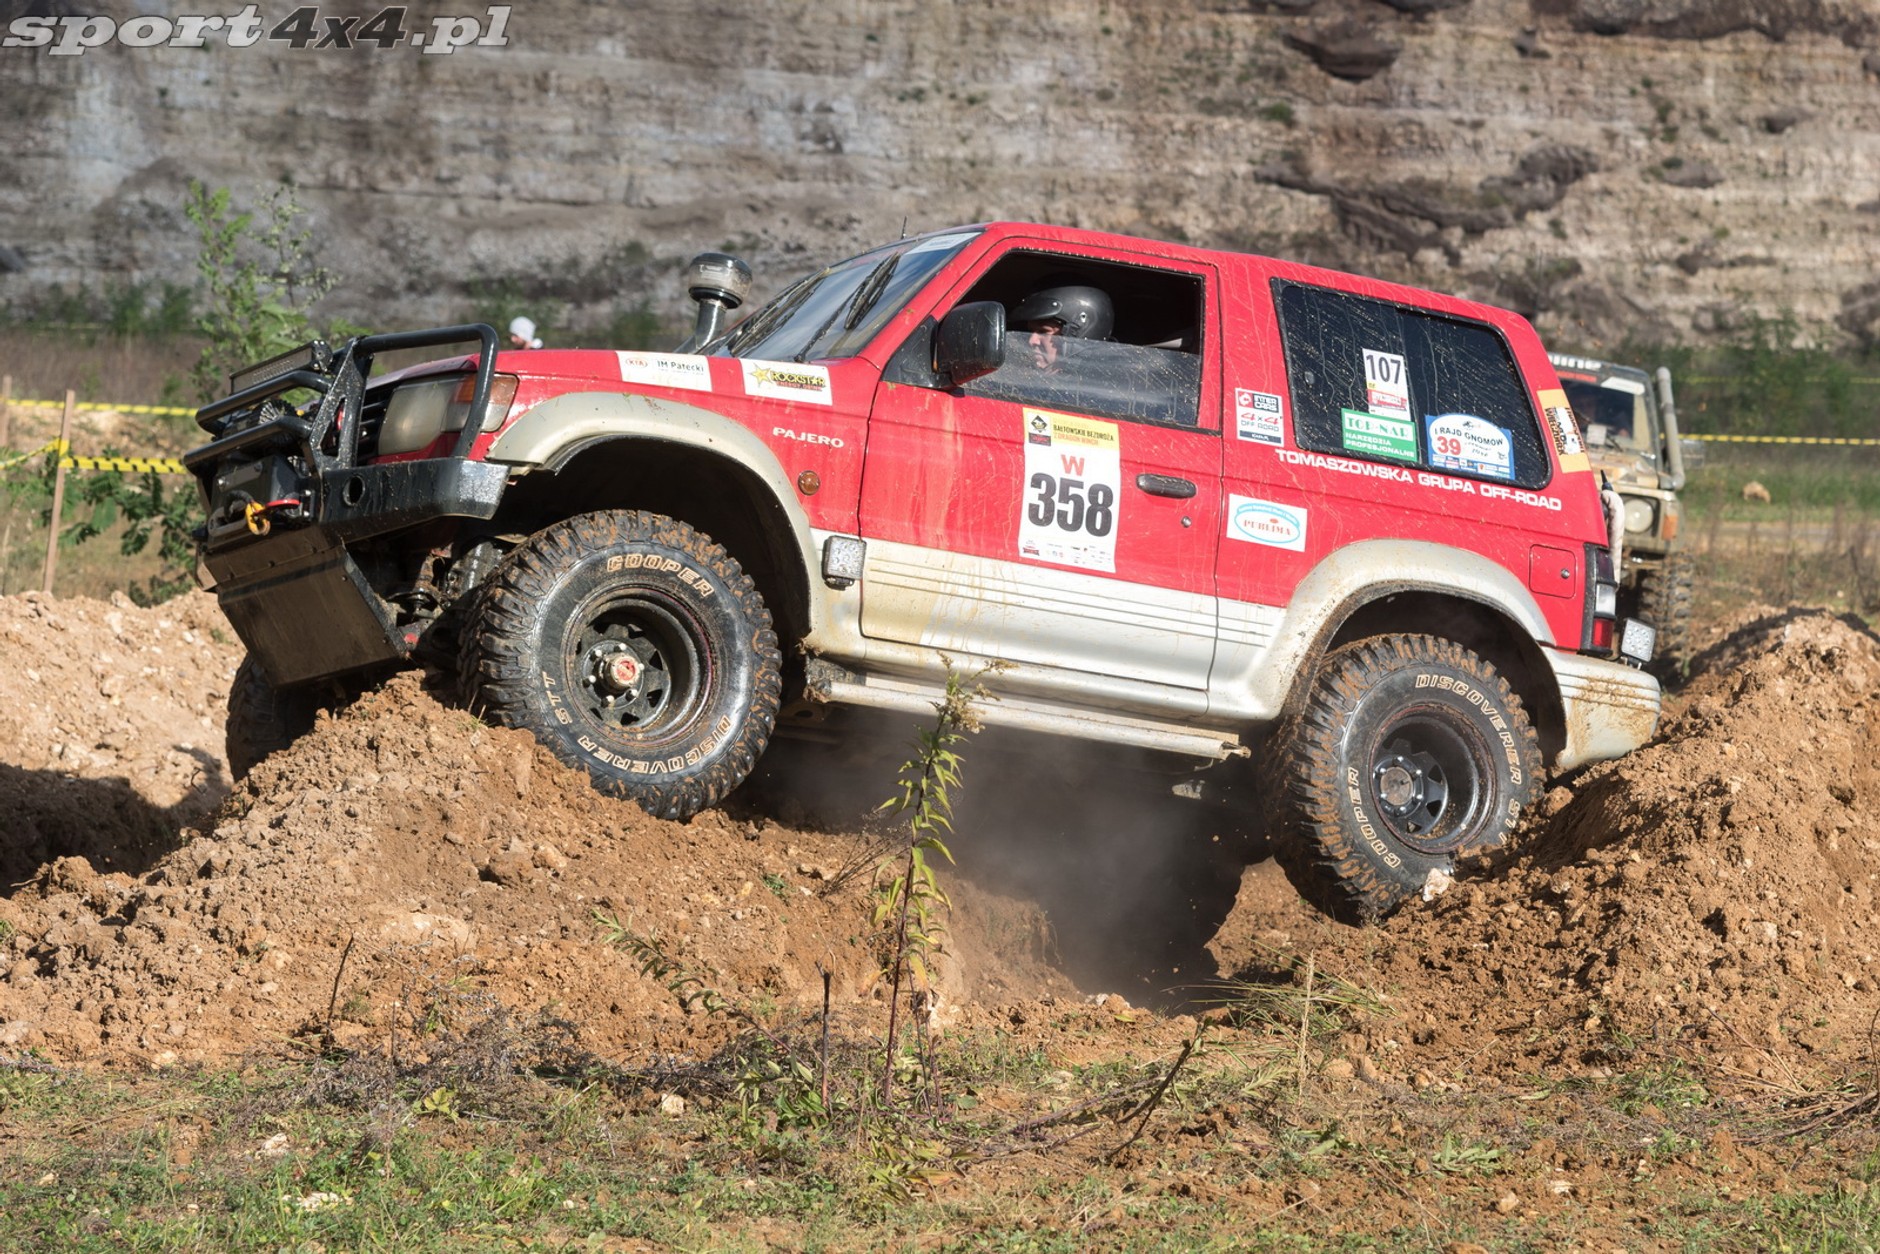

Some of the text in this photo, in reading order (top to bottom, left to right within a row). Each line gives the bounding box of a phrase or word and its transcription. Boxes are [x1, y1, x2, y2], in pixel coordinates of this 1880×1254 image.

[1366, 354, 1402, 384] 107
[772, 427, 844, 448] PAJERO
[1437, 436, 1461, 455] 39
[1440, 427, 1462, 436] RAJD
[1061, 454, 1085, 476] W
[1275, 449, 1413, 484] TOMASZOWSKA
[1418, 473, 1475, 494] GRUPA
[1480, 484, 1562, 511] OFF-ROAD
[1028, 472, 1114, 537] 358
[607, 554, 714, 597] COOPER
[578, 716, 731, 774] DISCOVERER
[1415, 674, 1522, 785] DISCOVERER
[1348, 767, 1401, 869] COOPER
